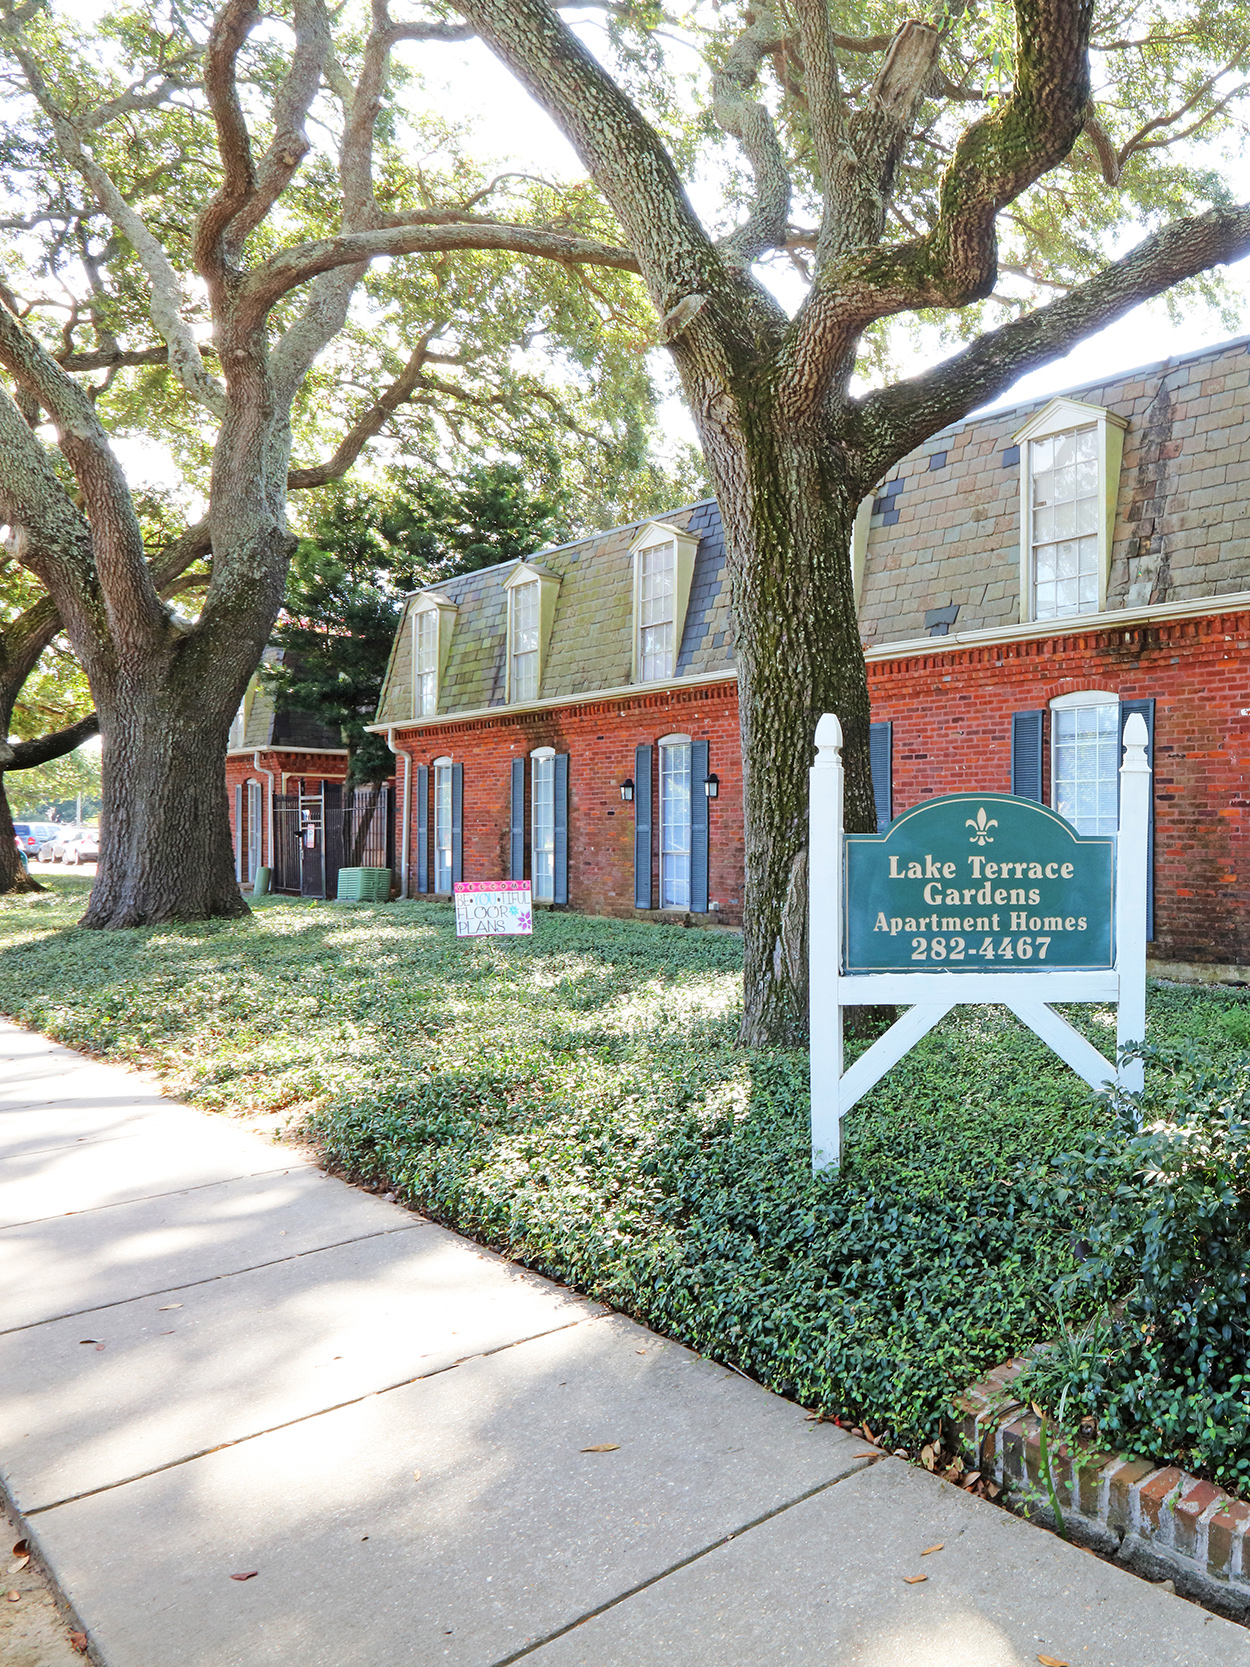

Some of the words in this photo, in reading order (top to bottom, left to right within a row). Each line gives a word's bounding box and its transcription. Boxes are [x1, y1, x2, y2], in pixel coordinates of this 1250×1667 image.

[888, 854, 957, 879] Lake
[967, 855, 1075, 879] Terrace
[456, 883, 527, 891] WELCOME
[923, 881, 1041, 905] Gardens
[457, 905, 508, 920] FLOOR
[873, 912, 1000, 936] Apartment
[1009, 912, 1088, 931] Homes
[458, 920, 506, 934] PLANS
[911, 937, 1052, 960] 282-4467
